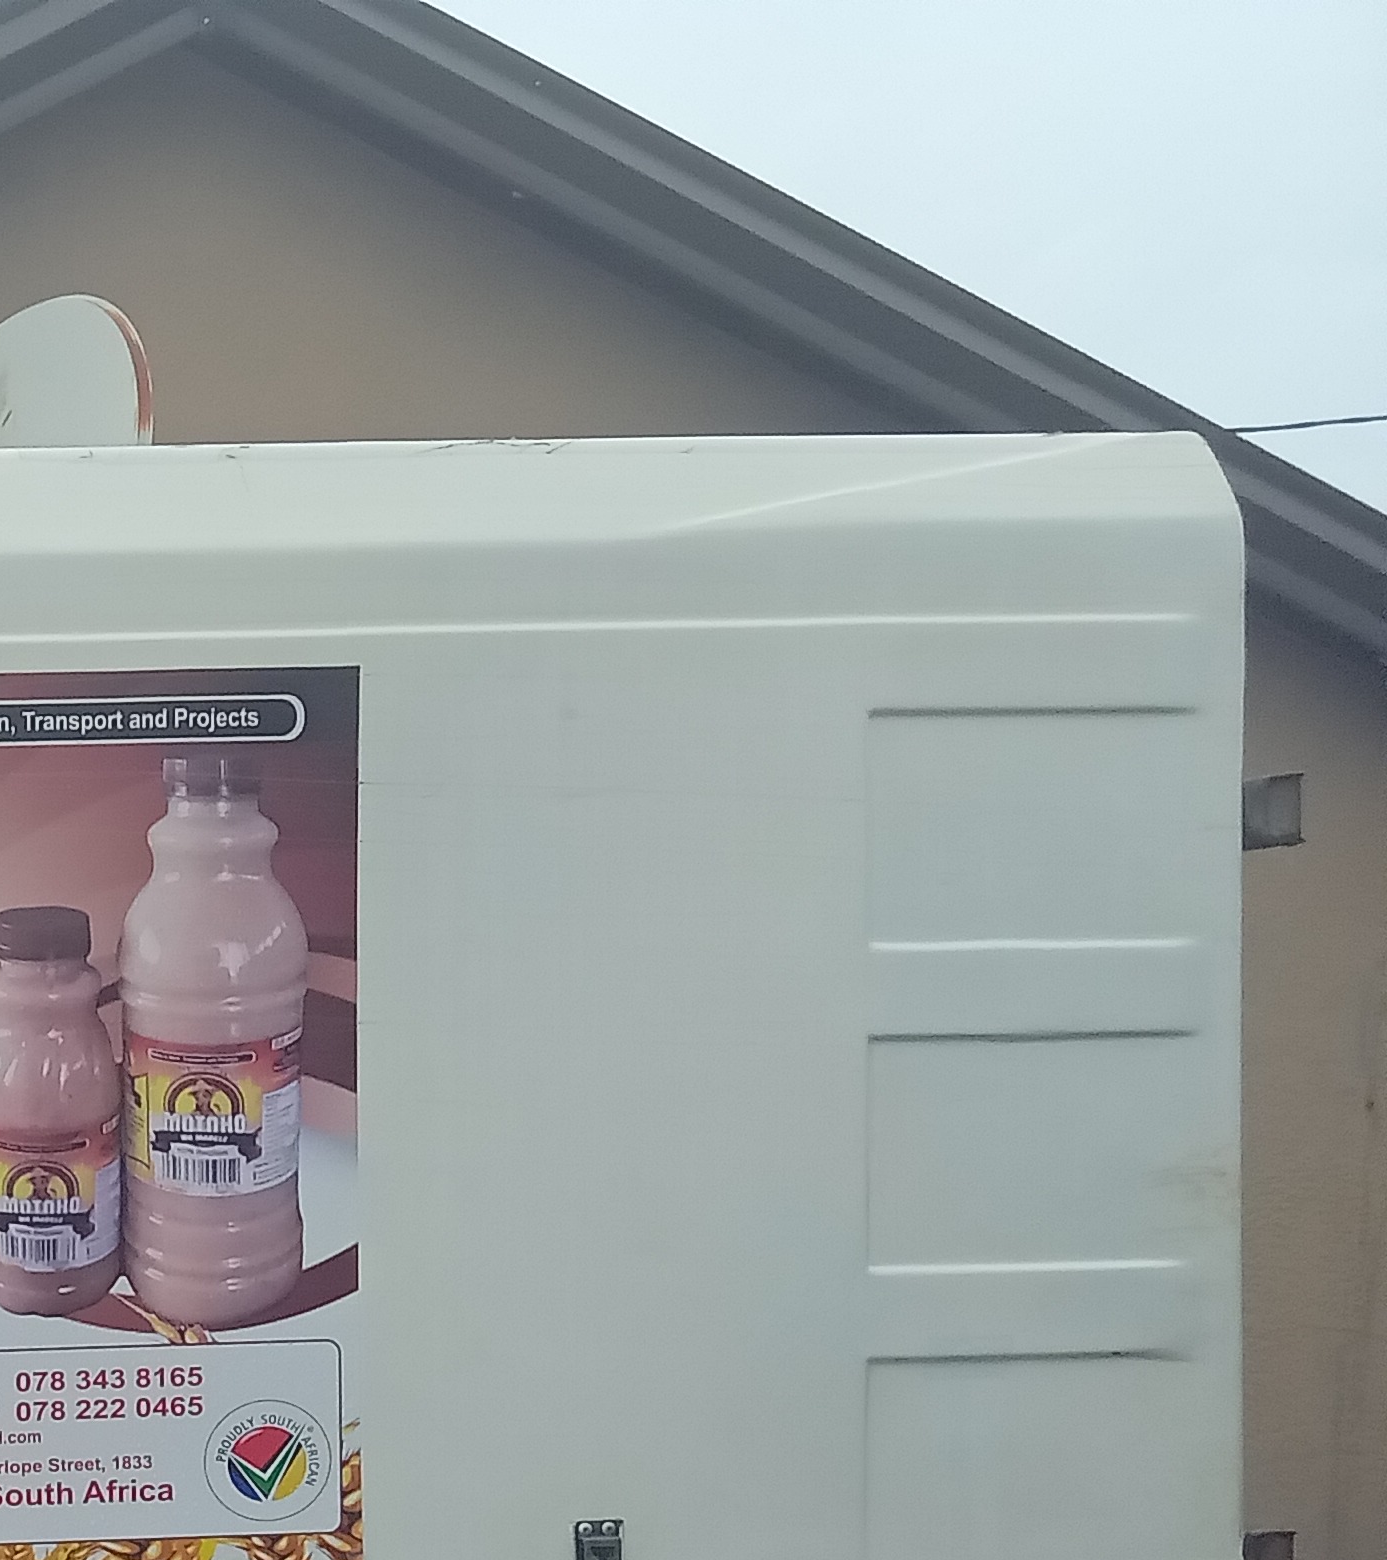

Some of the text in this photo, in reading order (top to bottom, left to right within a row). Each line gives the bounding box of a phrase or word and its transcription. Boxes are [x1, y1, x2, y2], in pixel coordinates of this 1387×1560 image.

[22, 709, 123, 738] Transport
[129, 709, 168, 730] and
[174, 706, 259, 732] Projects
[15, 1365, 204, 1393] 078 343 8165
[15, 1395, 204, 1423] 078 222 0465
[48, 1456, 106, 1475] Street,
[113, 1454, 153, 1471] 1833
[216, 1414, 320, 1487] PROUDLY SOUTH AFRICAN
[82, 1477, 174, 1505] Africa
